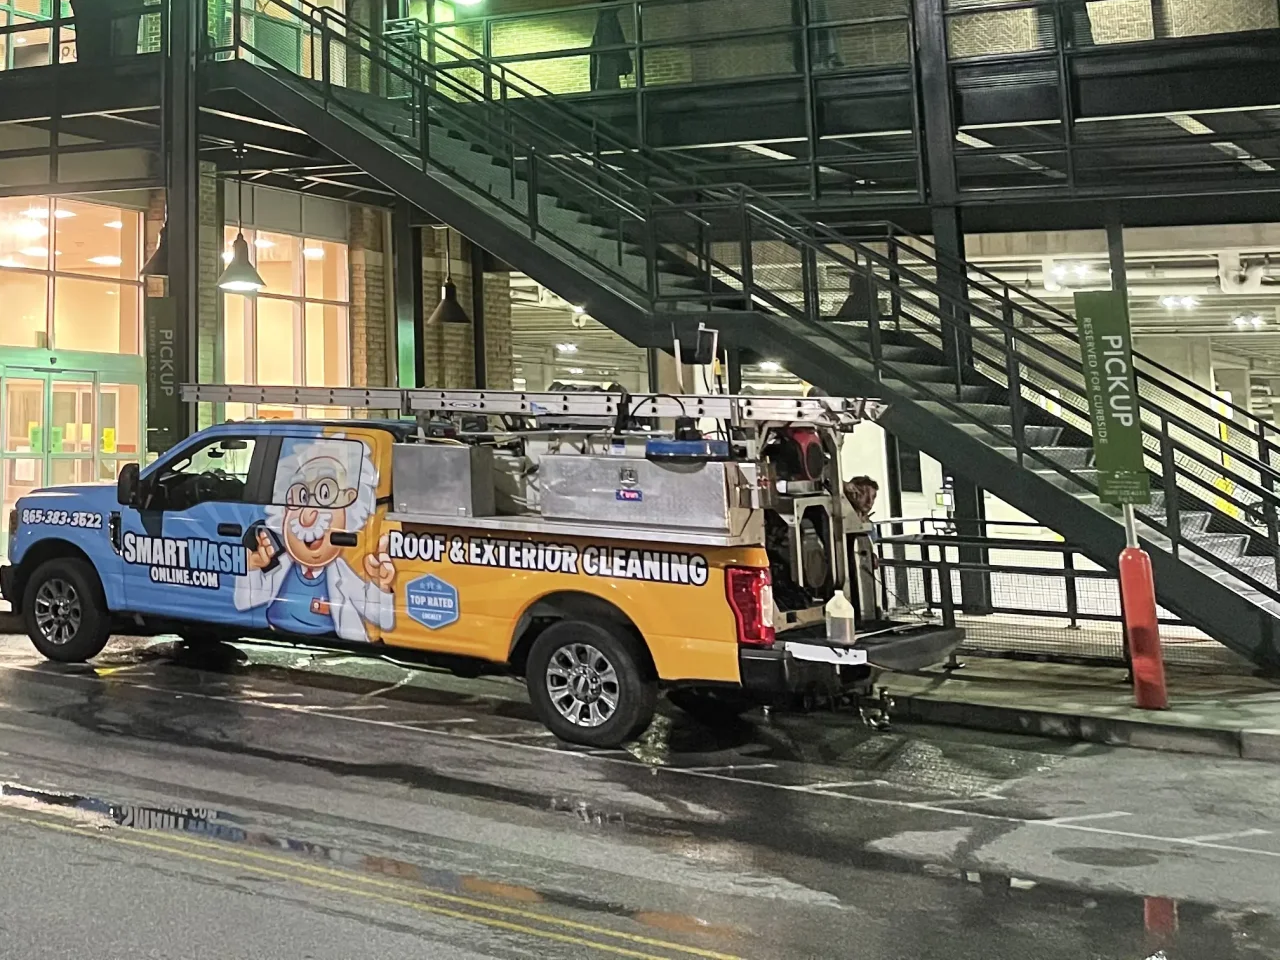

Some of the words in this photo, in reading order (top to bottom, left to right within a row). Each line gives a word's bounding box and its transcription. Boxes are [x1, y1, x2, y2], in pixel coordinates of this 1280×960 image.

[159, 329, 174, 396] PICKUP
[1083, 317, 1098, 368] RESERVED
[1090, 371, 1101, 391] FOR
[1101, 335, 1133, 427] PICKUP
[1093, 395, 1109, 444] CURBSIDE
[150, 566, 218, 588] ONLINE.COM
[389, 531, 446, 561] ROOF
[449, 537, 466, 563] &
[470, 538, 578, 573] EXTERIOR
[583, 545, 708, 585] CLEANING
[410, 595, 426, 606] TOP
[427, 596, 454, 608] RATED
